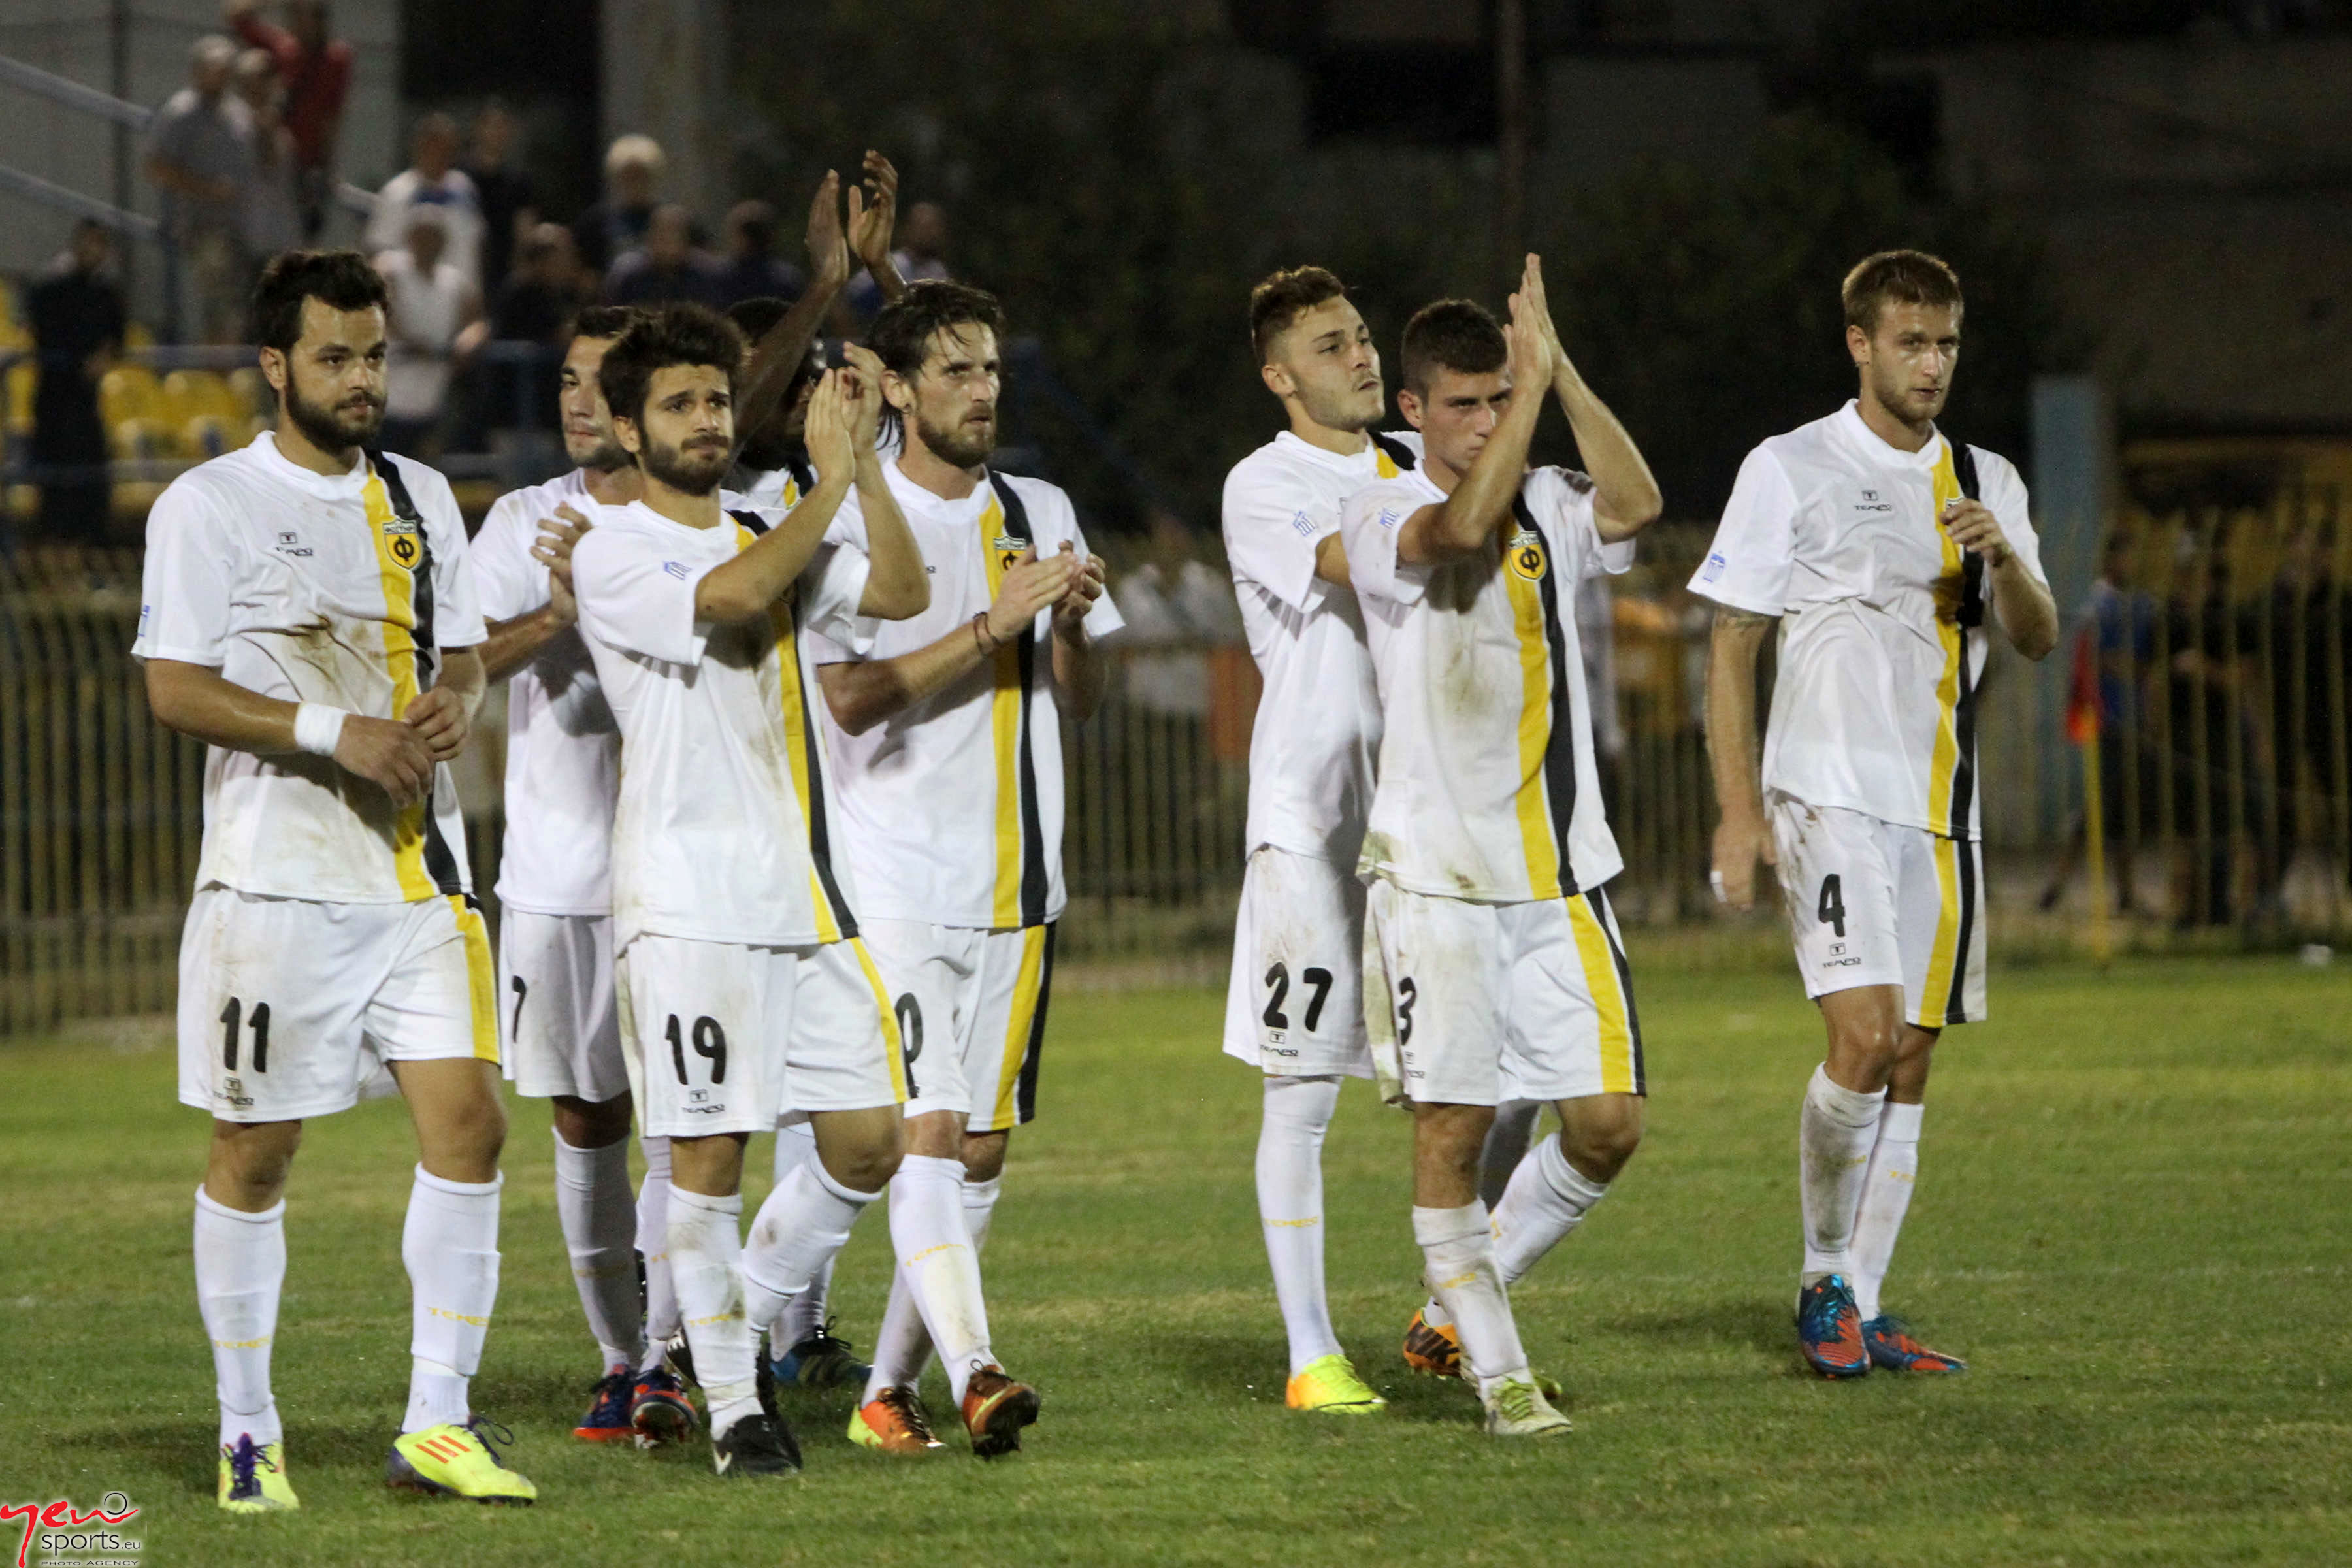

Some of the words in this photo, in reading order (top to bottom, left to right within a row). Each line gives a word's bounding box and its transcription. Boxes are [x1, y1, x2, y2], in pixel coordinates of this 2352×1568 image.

[1818, 872, 1846, 938] 4
[1262, 961, 1333, 1032] 27
[1822, 956, 1861, 968] TEMPO
[220, 996, 270, 1073] 11
[664, 1013, 728, 1085] 19
